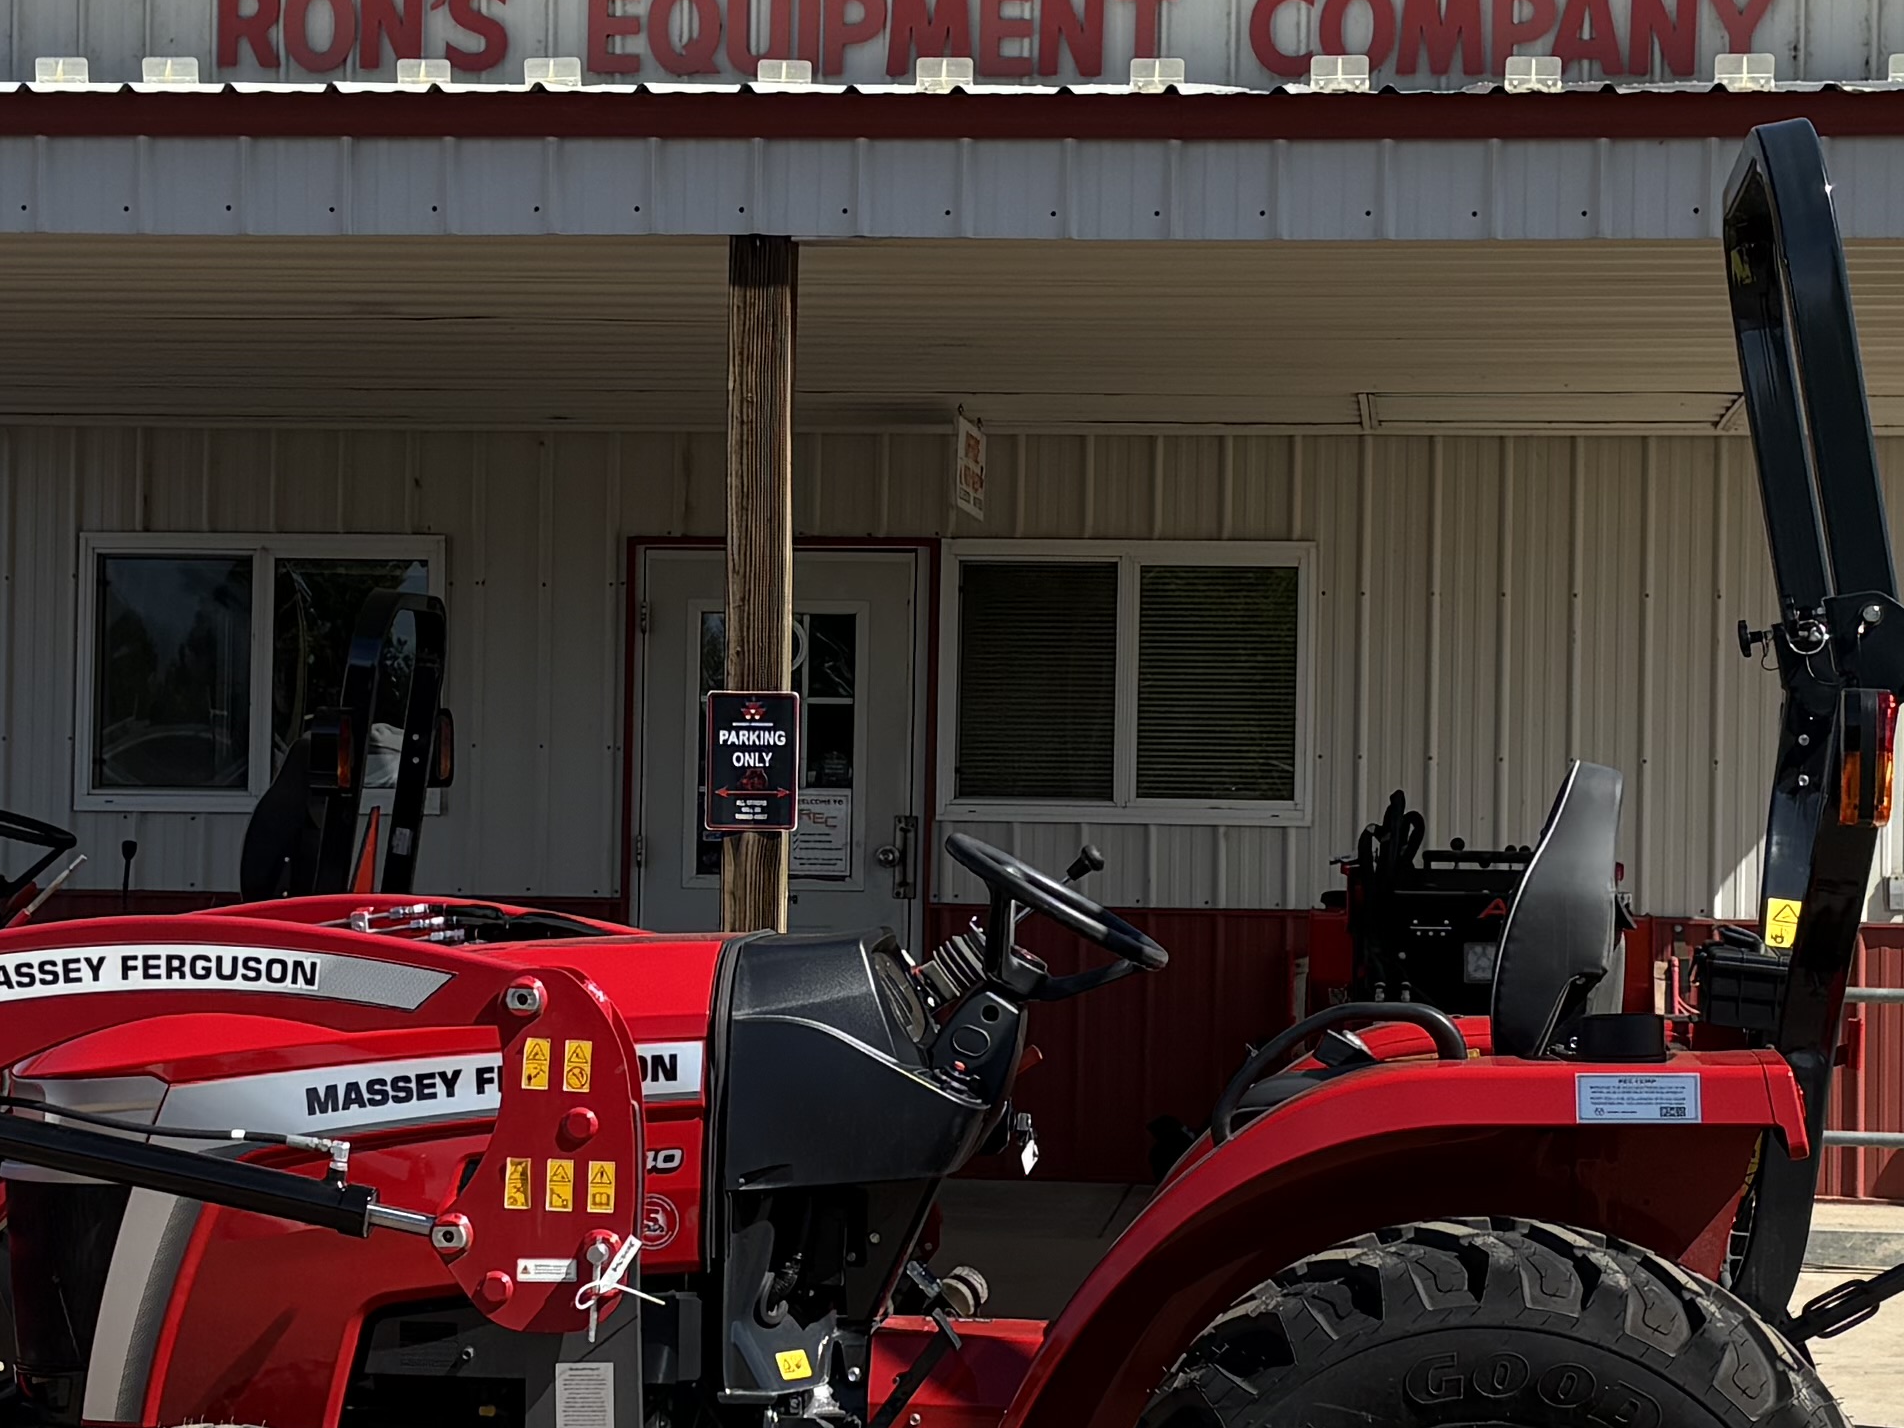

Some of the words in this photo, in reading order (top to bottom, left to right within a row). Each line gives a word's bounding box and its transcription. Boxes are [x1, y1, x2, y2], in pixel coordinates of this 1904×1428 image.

[718, 730, 786, 746] PARKING
[732, 752, 773, 767] ONLY
[121, 954, 318, 987] FERGUSON
[305, 1068, 462, 1117] MASSEY
